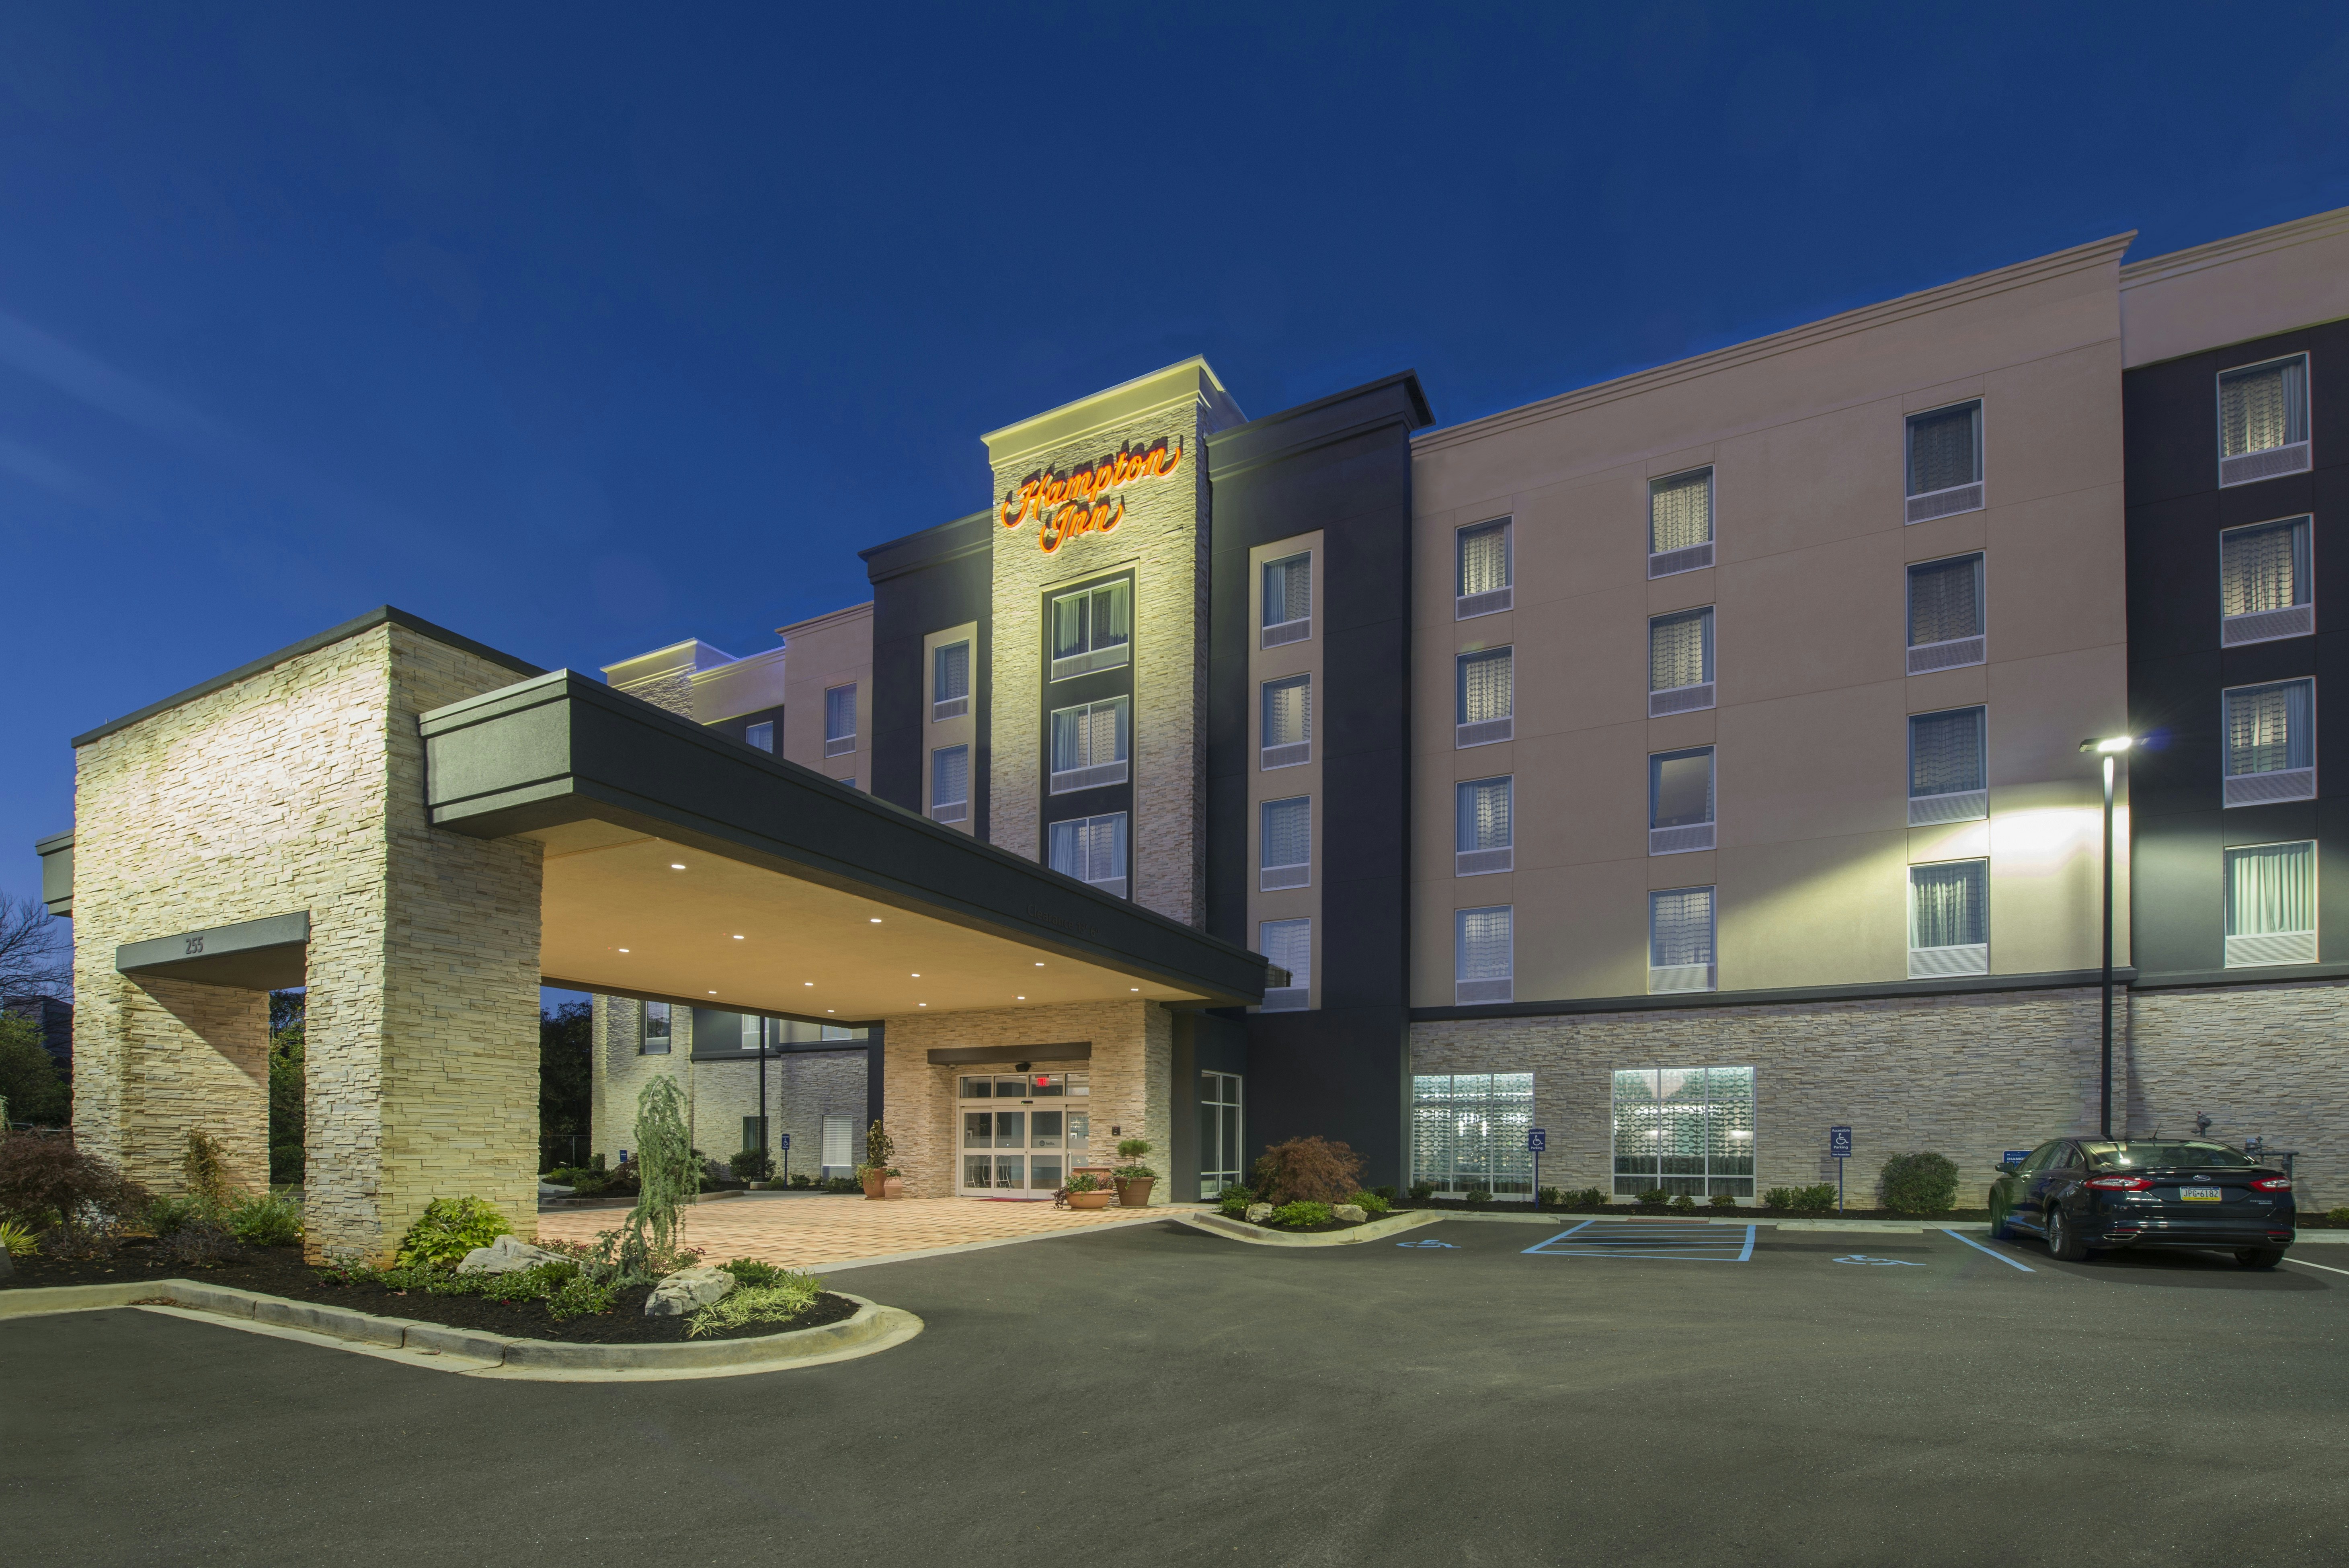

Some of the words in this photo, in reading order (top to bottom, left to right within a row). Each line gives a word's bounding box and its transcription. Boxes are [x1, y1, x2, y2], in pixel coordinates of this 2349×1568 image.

[1000, 447, 1182, 529] Hampton
[1039, 503, 1124, 554] Inn
[186, 936, 203, 954] 255
